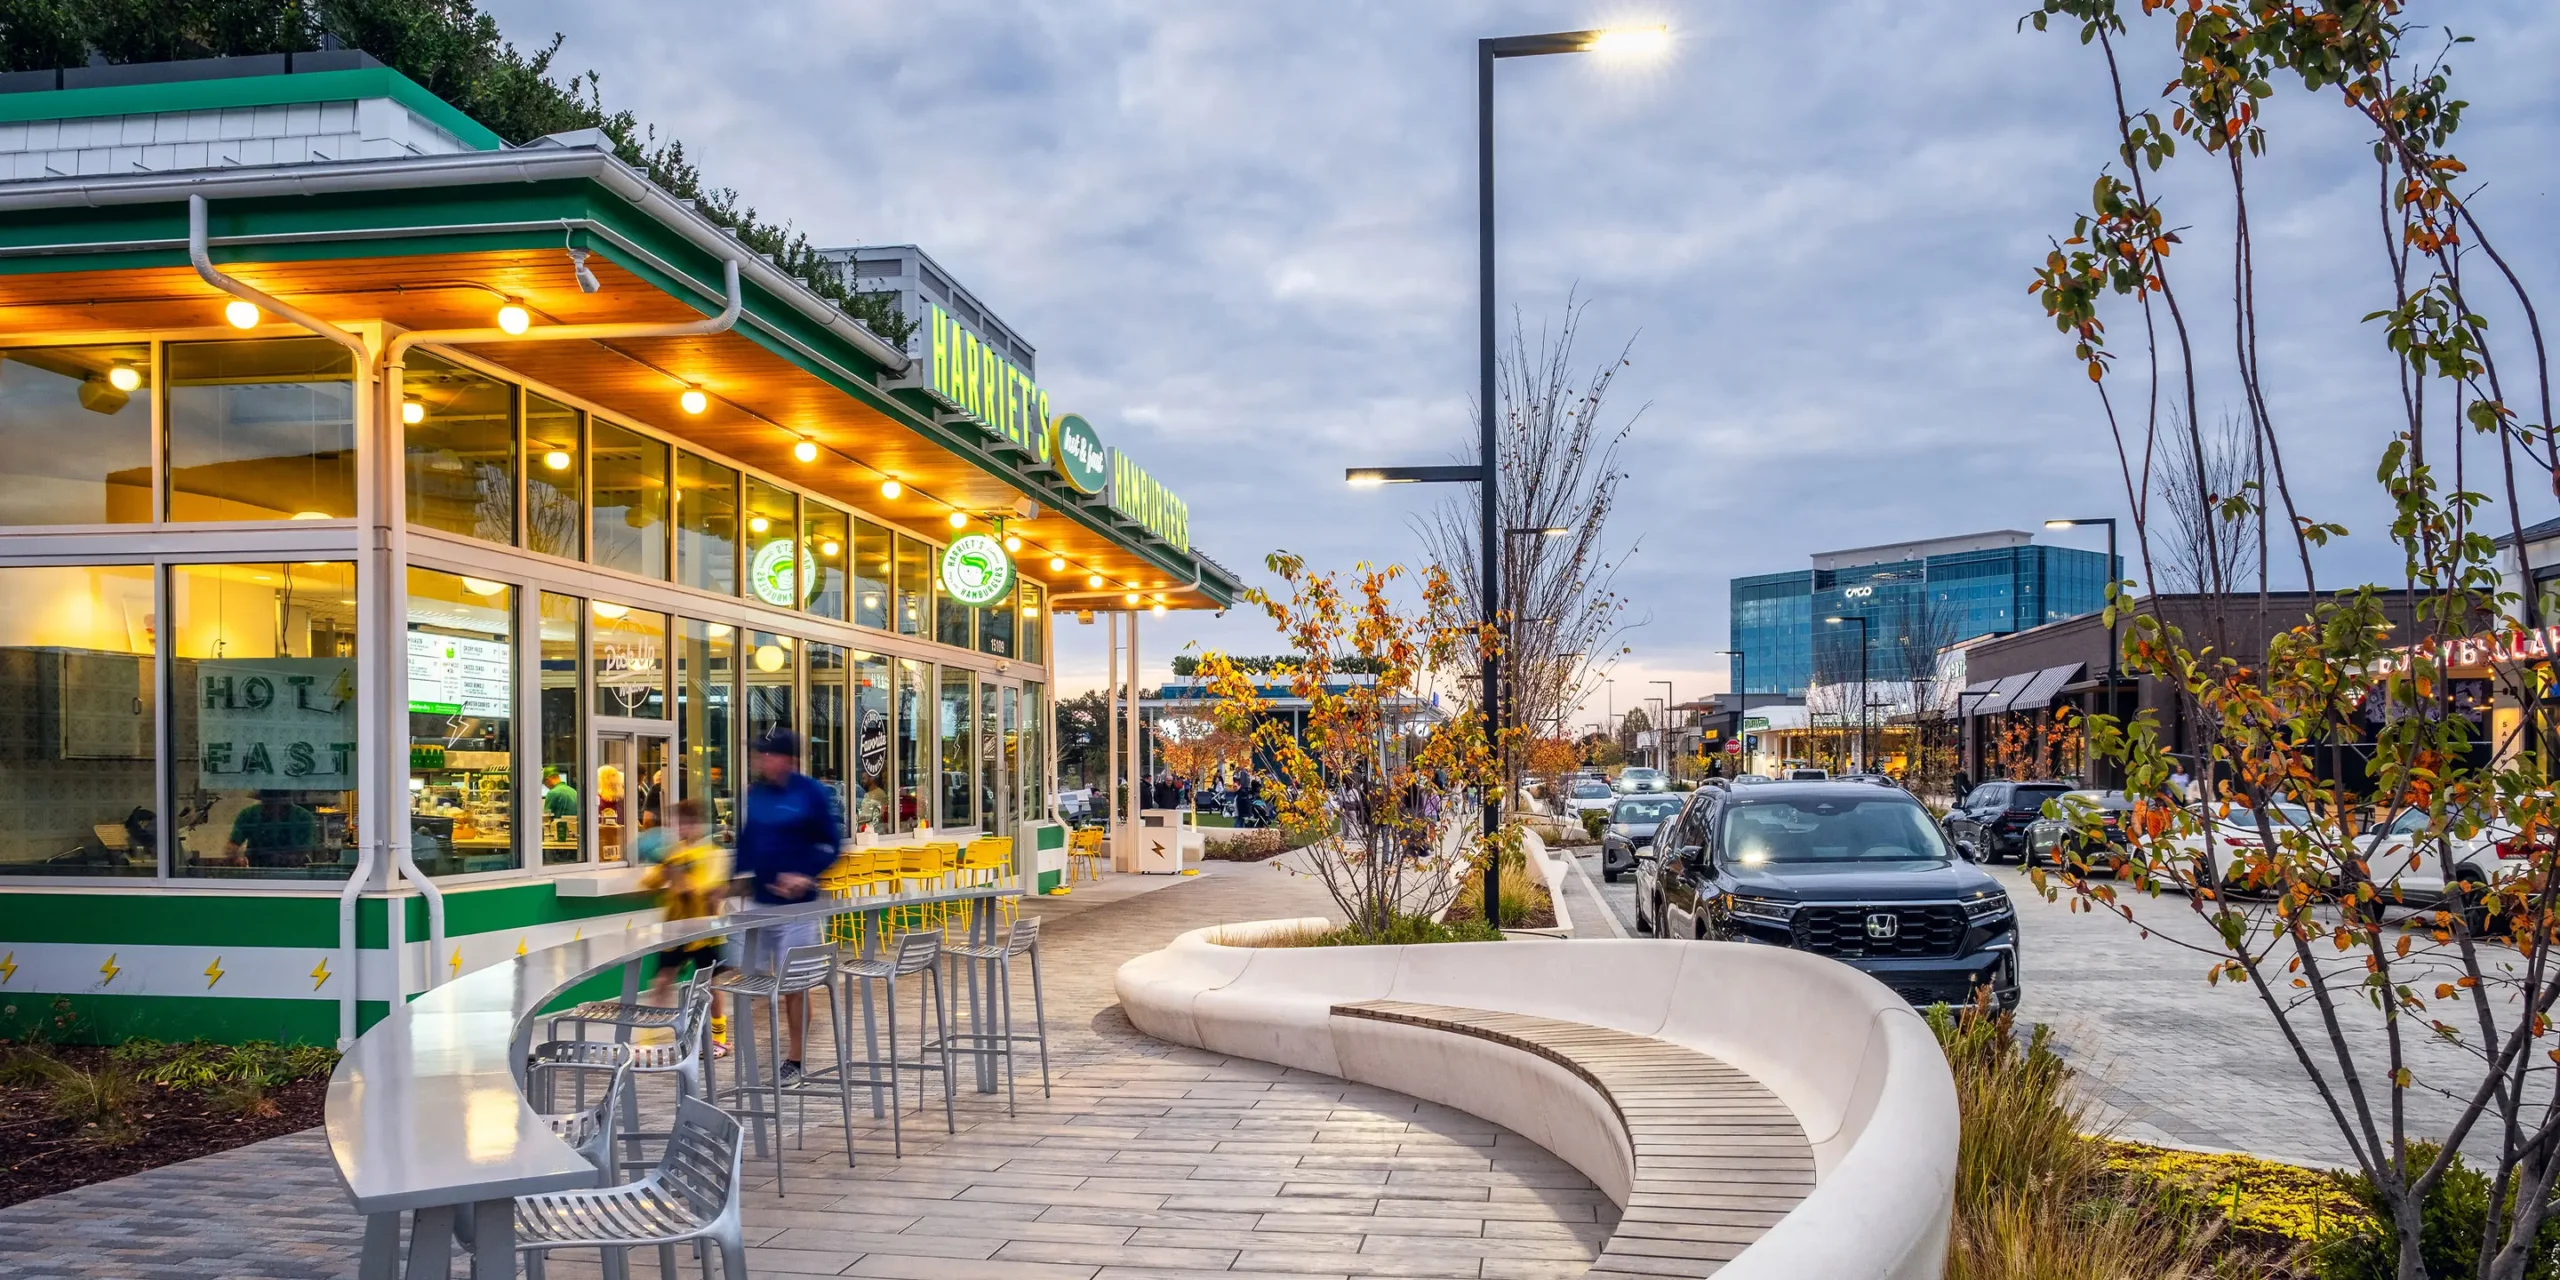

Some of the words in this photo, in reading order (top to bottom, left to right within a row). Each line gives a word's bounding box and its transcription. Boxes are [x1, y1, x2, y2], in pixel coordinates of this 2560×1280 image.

[932, 302, 1050, 463] HARRIET'S
[1064, 426, 1080, 457] hot
[1079, 437, 1087, 463] &
[1085, 443, 1104, 474] fast
[1114, 447, 1189, 554] HAMBURGERS
[947, 539, 985, 567] HARRIET'S
[961, 566, 1004, 600] HAMBURGERS
[604, 642, 635, 677] Pick
[638, 635, 657, 677] Up
[200, 676, 315, 710] HOT
[201, 741, 357, 777] FAST
[860, 731, 887, 757] Favorite
